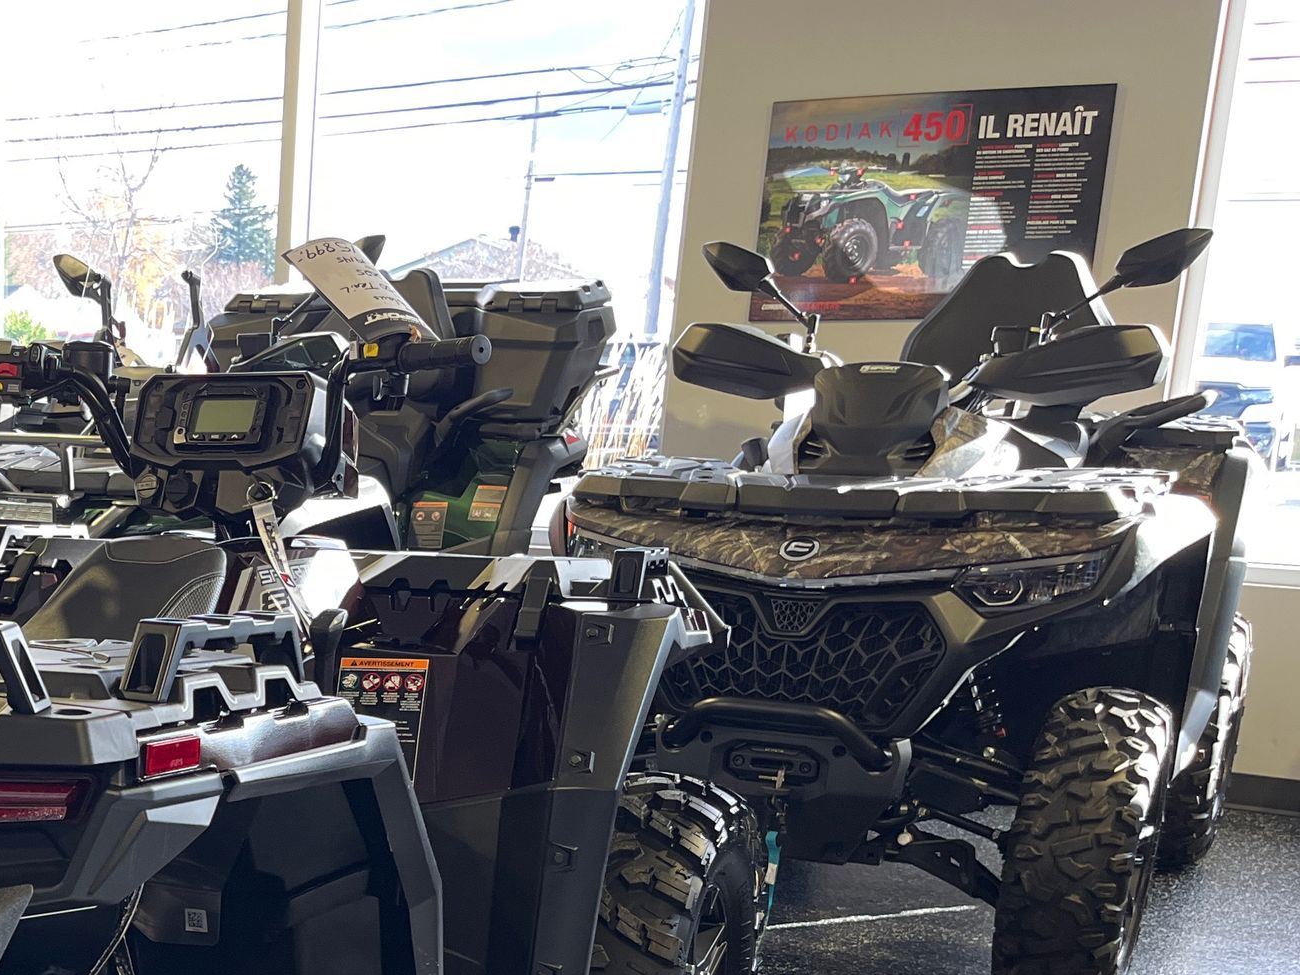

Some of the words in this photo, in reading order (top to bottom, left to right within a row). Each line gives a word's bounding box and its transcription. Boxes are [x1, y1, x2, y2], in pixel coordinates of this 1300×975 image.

[784, 119, 894, 144] KODIAK
[902, 109, 967, 142] 450
[977, 114, 1001, 139] IL
[1005, 105, 1099, 138] RENAÎT
[358, 659, 415, 668] AVERTISSEMENT
